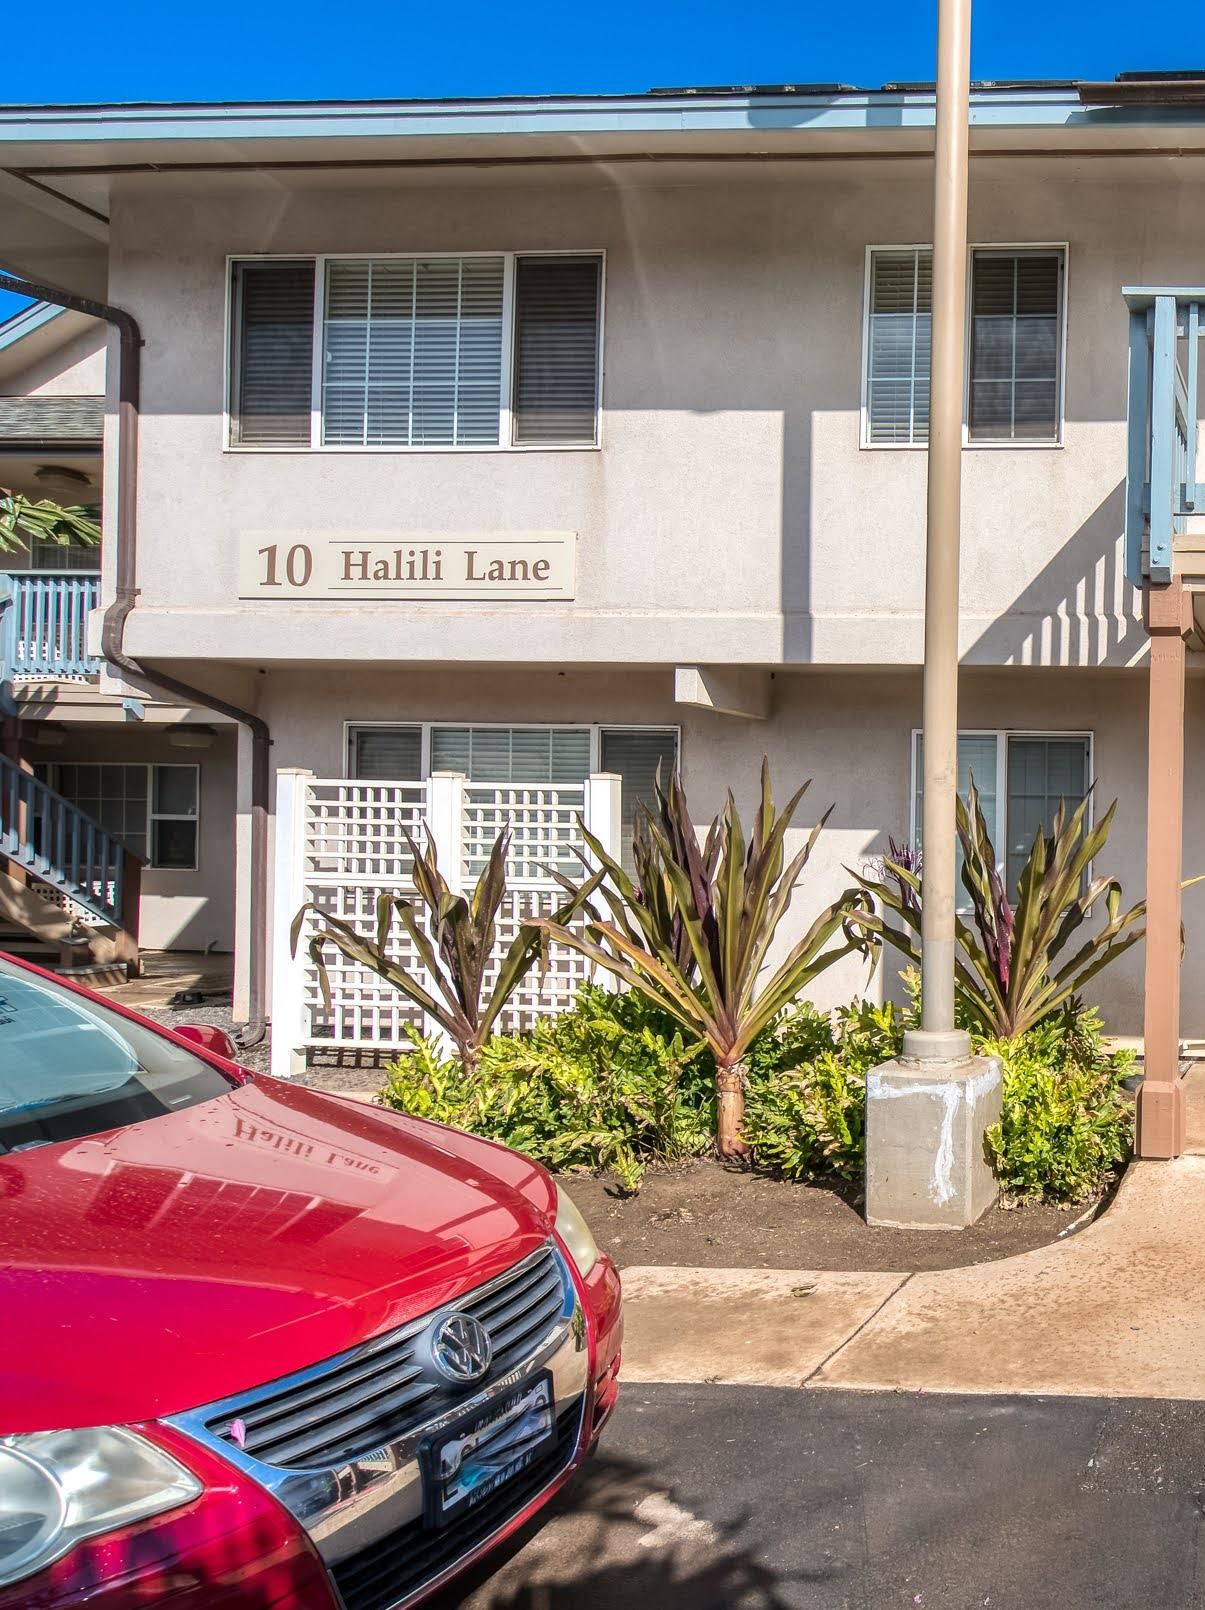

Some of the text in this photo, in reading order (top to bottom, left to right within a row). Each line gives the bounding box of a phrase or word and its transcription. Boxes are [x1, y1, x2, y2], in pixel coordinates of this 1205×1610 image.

[258, 544, 551, 587] 10 Halili Lane
